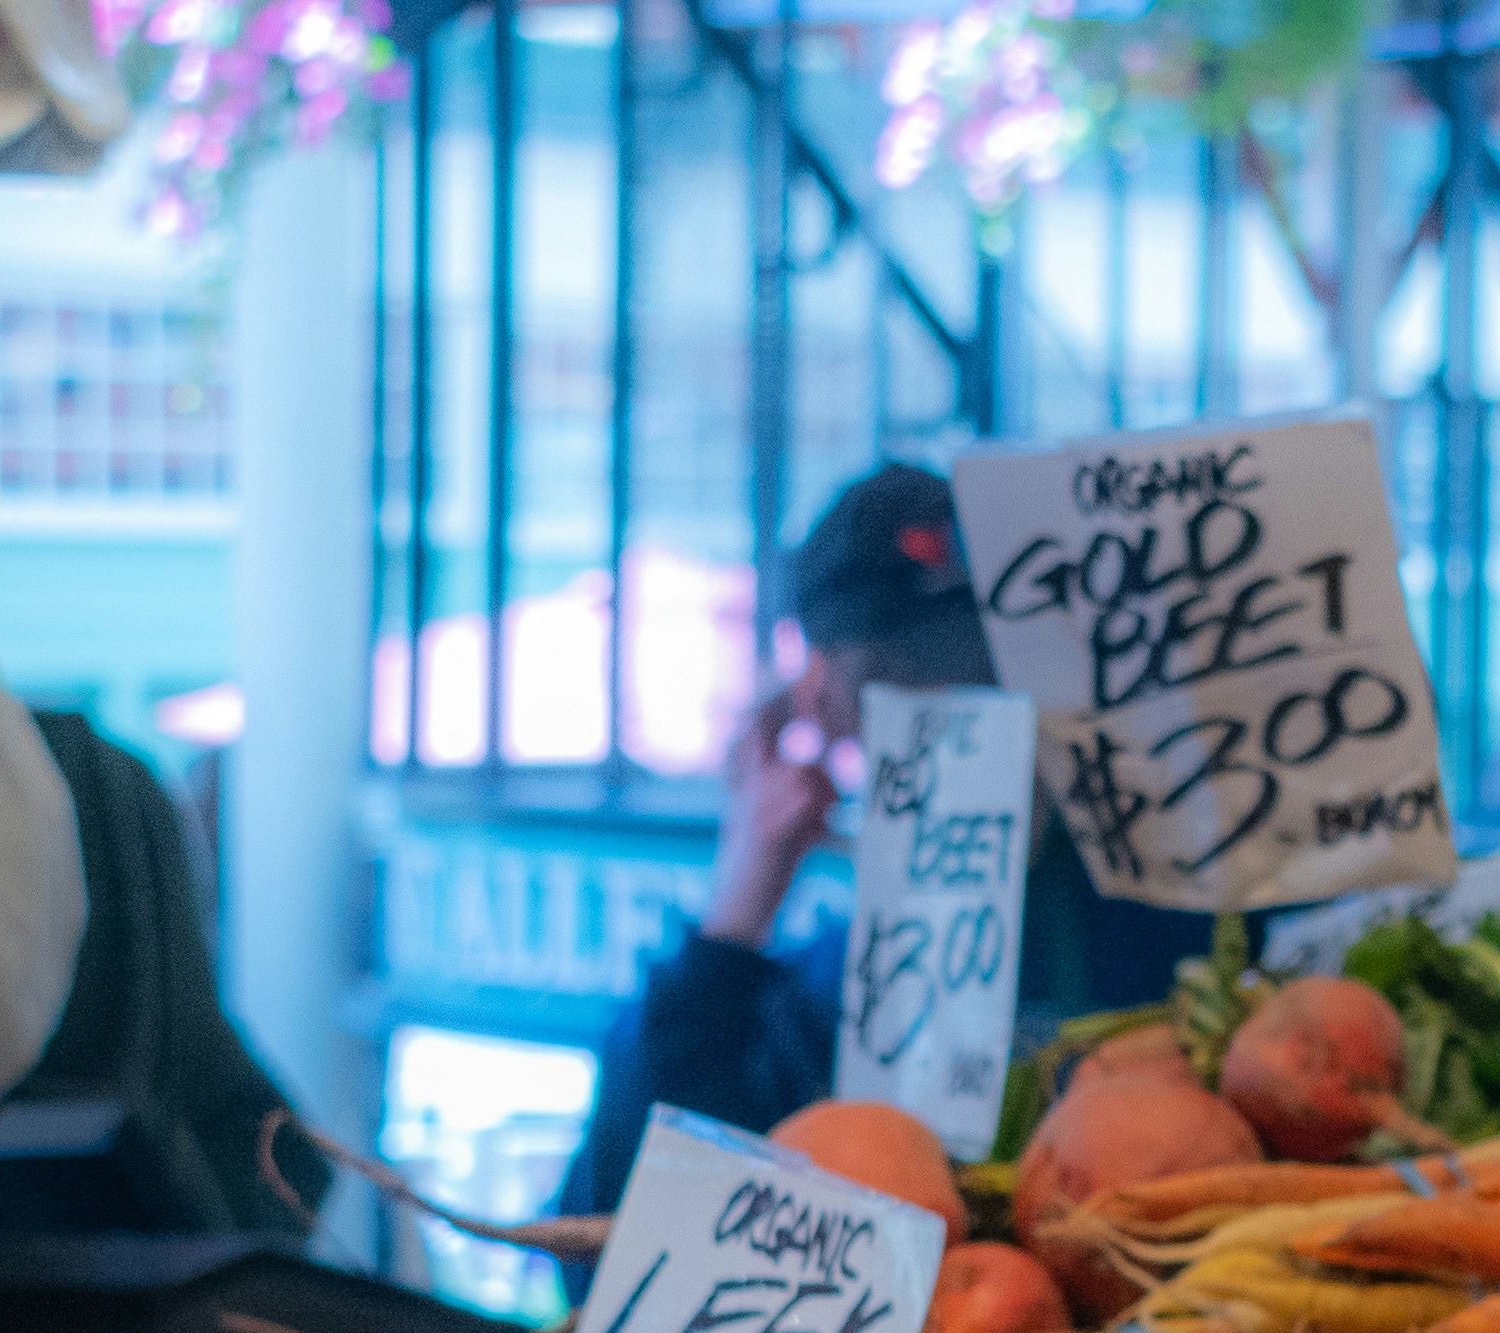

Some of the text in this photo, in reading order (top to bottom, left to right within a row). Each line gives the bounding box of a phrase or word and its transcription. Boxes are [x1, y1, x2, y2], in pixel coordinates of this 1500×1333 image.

[989, 499, 1263, 620] GOLD
[1090, 550, 1354, 712] BEET
[712, 1177, 878, 1282] ORGANIC
